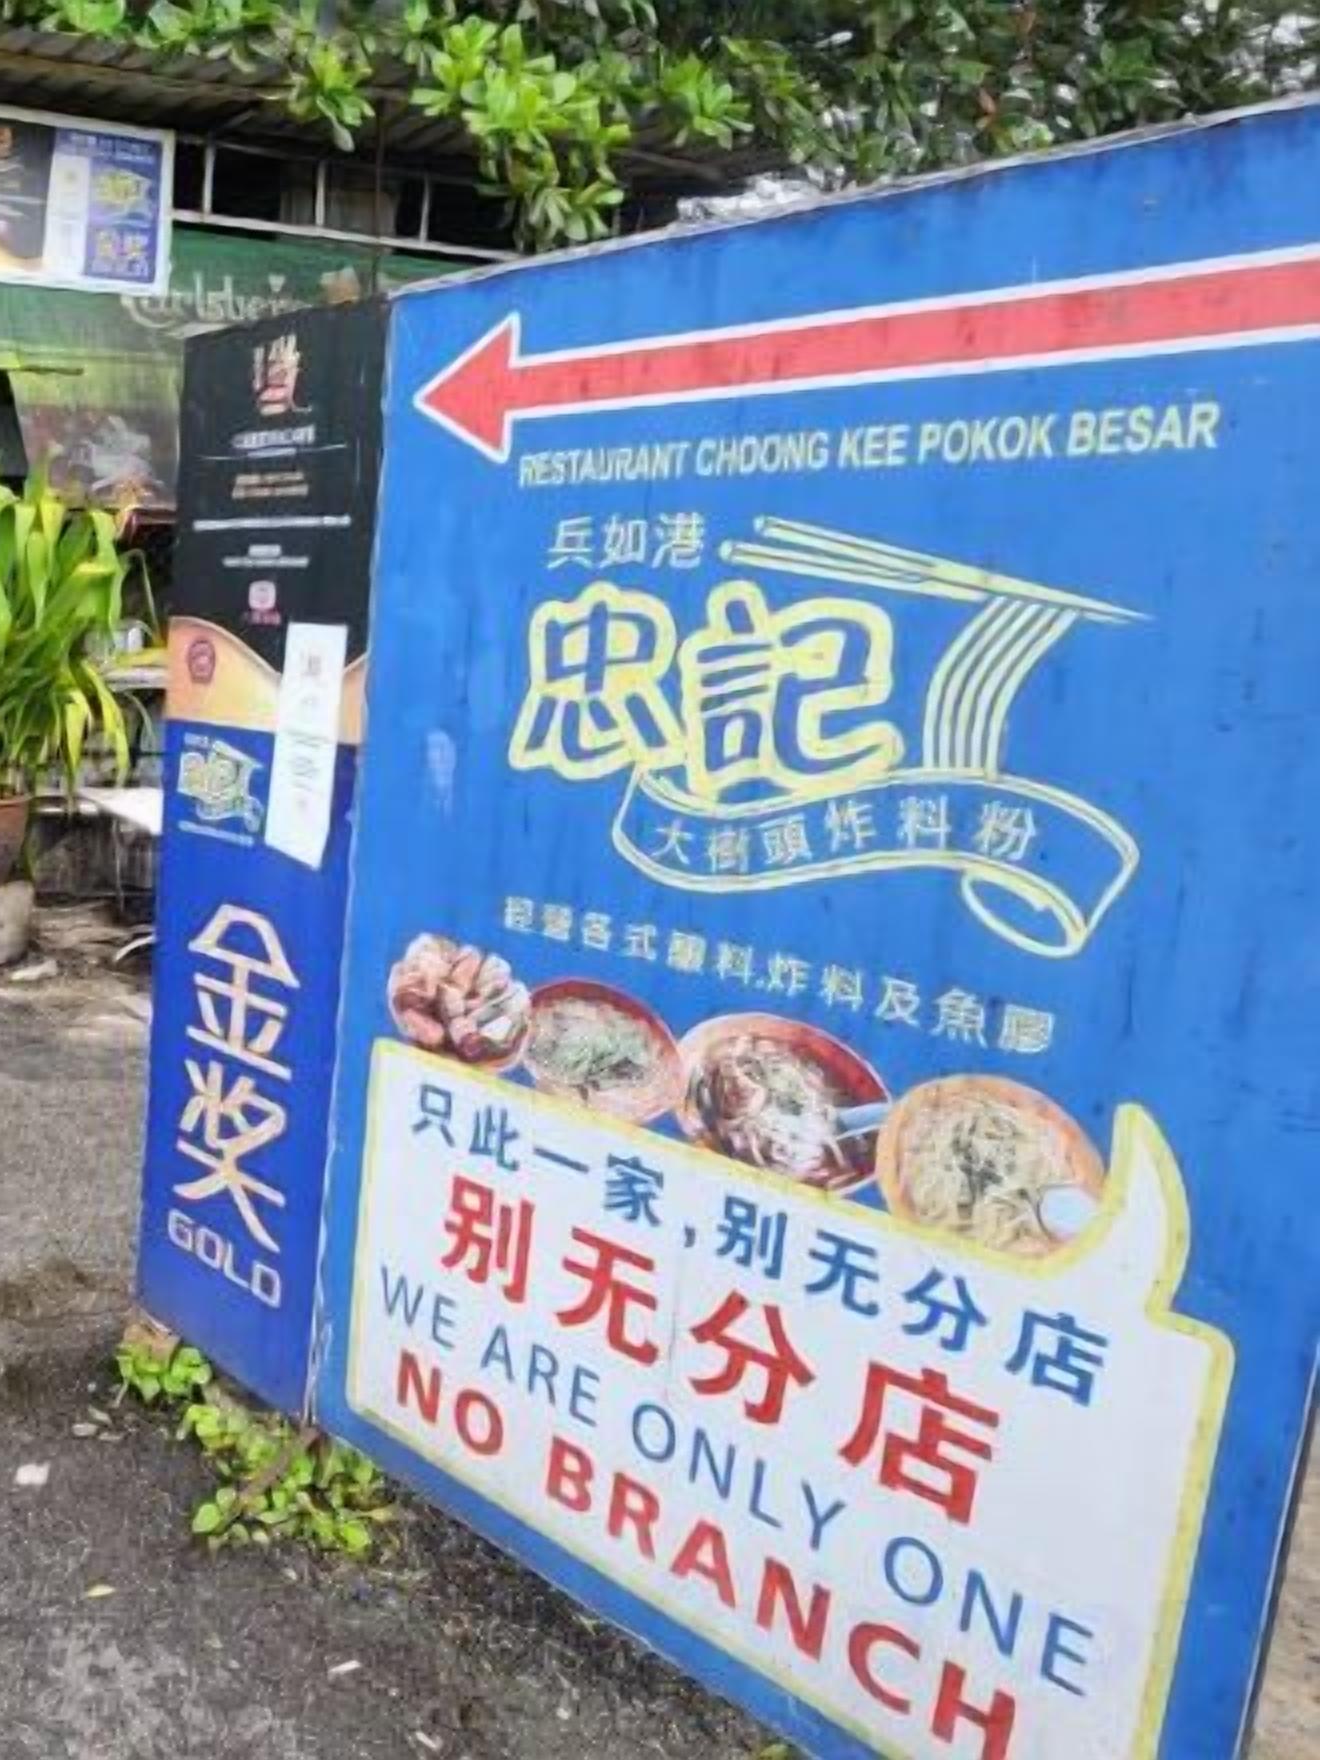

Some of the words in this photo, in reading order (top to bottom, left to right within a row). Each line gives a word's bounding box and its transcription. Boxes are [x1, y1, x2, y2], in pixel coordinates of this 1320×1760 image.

[518, 441, 690, 488] RESTAURANT
[694, 428, 830, 478] CHOONG
[836, 423, 912, 470] KEE
[917, 411, 1058, 466] POKOK
[1065, 400, 1222, 457] BESAR
[546, 510, 707, 572] 兵如港
[508, 579, 906, 810] 忠記
[172, 902, 301, 1255] 金奖
[166, 1207, 282, 1308] GOLD
[440, 1174, 1002, 1527] 别无分店
[382, 1264, 457, 1350] WE
[481, 1324, 601, 1427] ARE
[630, 1400, 845, 1554] ONLY
[882, 1534, 1096, 1698] ONE
[396, 1352, 506, 1457] NO
[545, 1437, 1018, 1760] BRANCH
